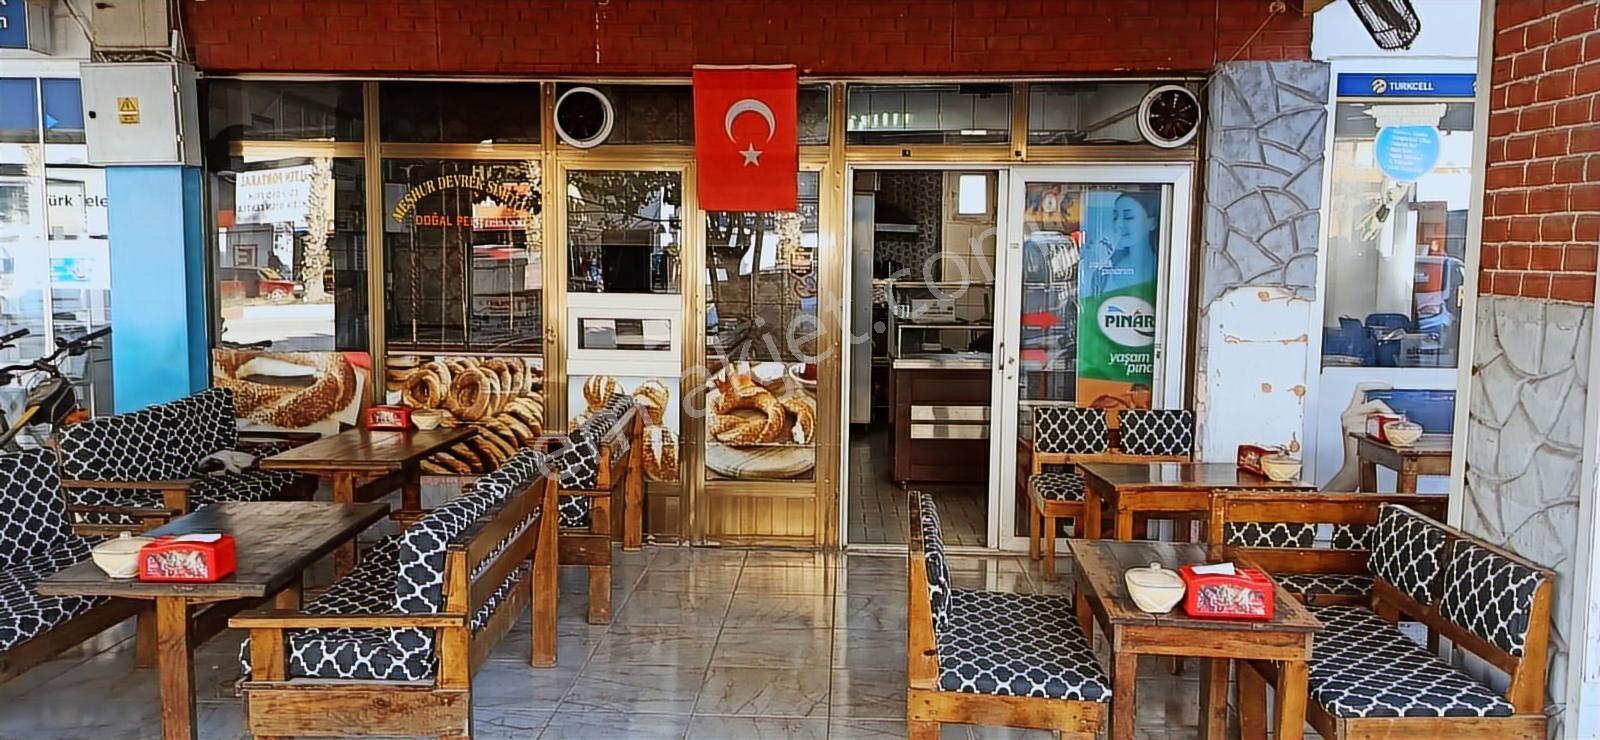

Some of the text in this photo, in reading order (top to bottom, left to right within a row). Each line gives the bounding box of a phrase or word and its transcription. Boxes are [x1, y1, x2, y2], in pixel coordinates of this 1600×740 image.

[1389, 81, 1435, 91] TURKCELL
[415, 211, 453, 227] DOĞAL
[1108, 353, 1150, 366] yaşam
